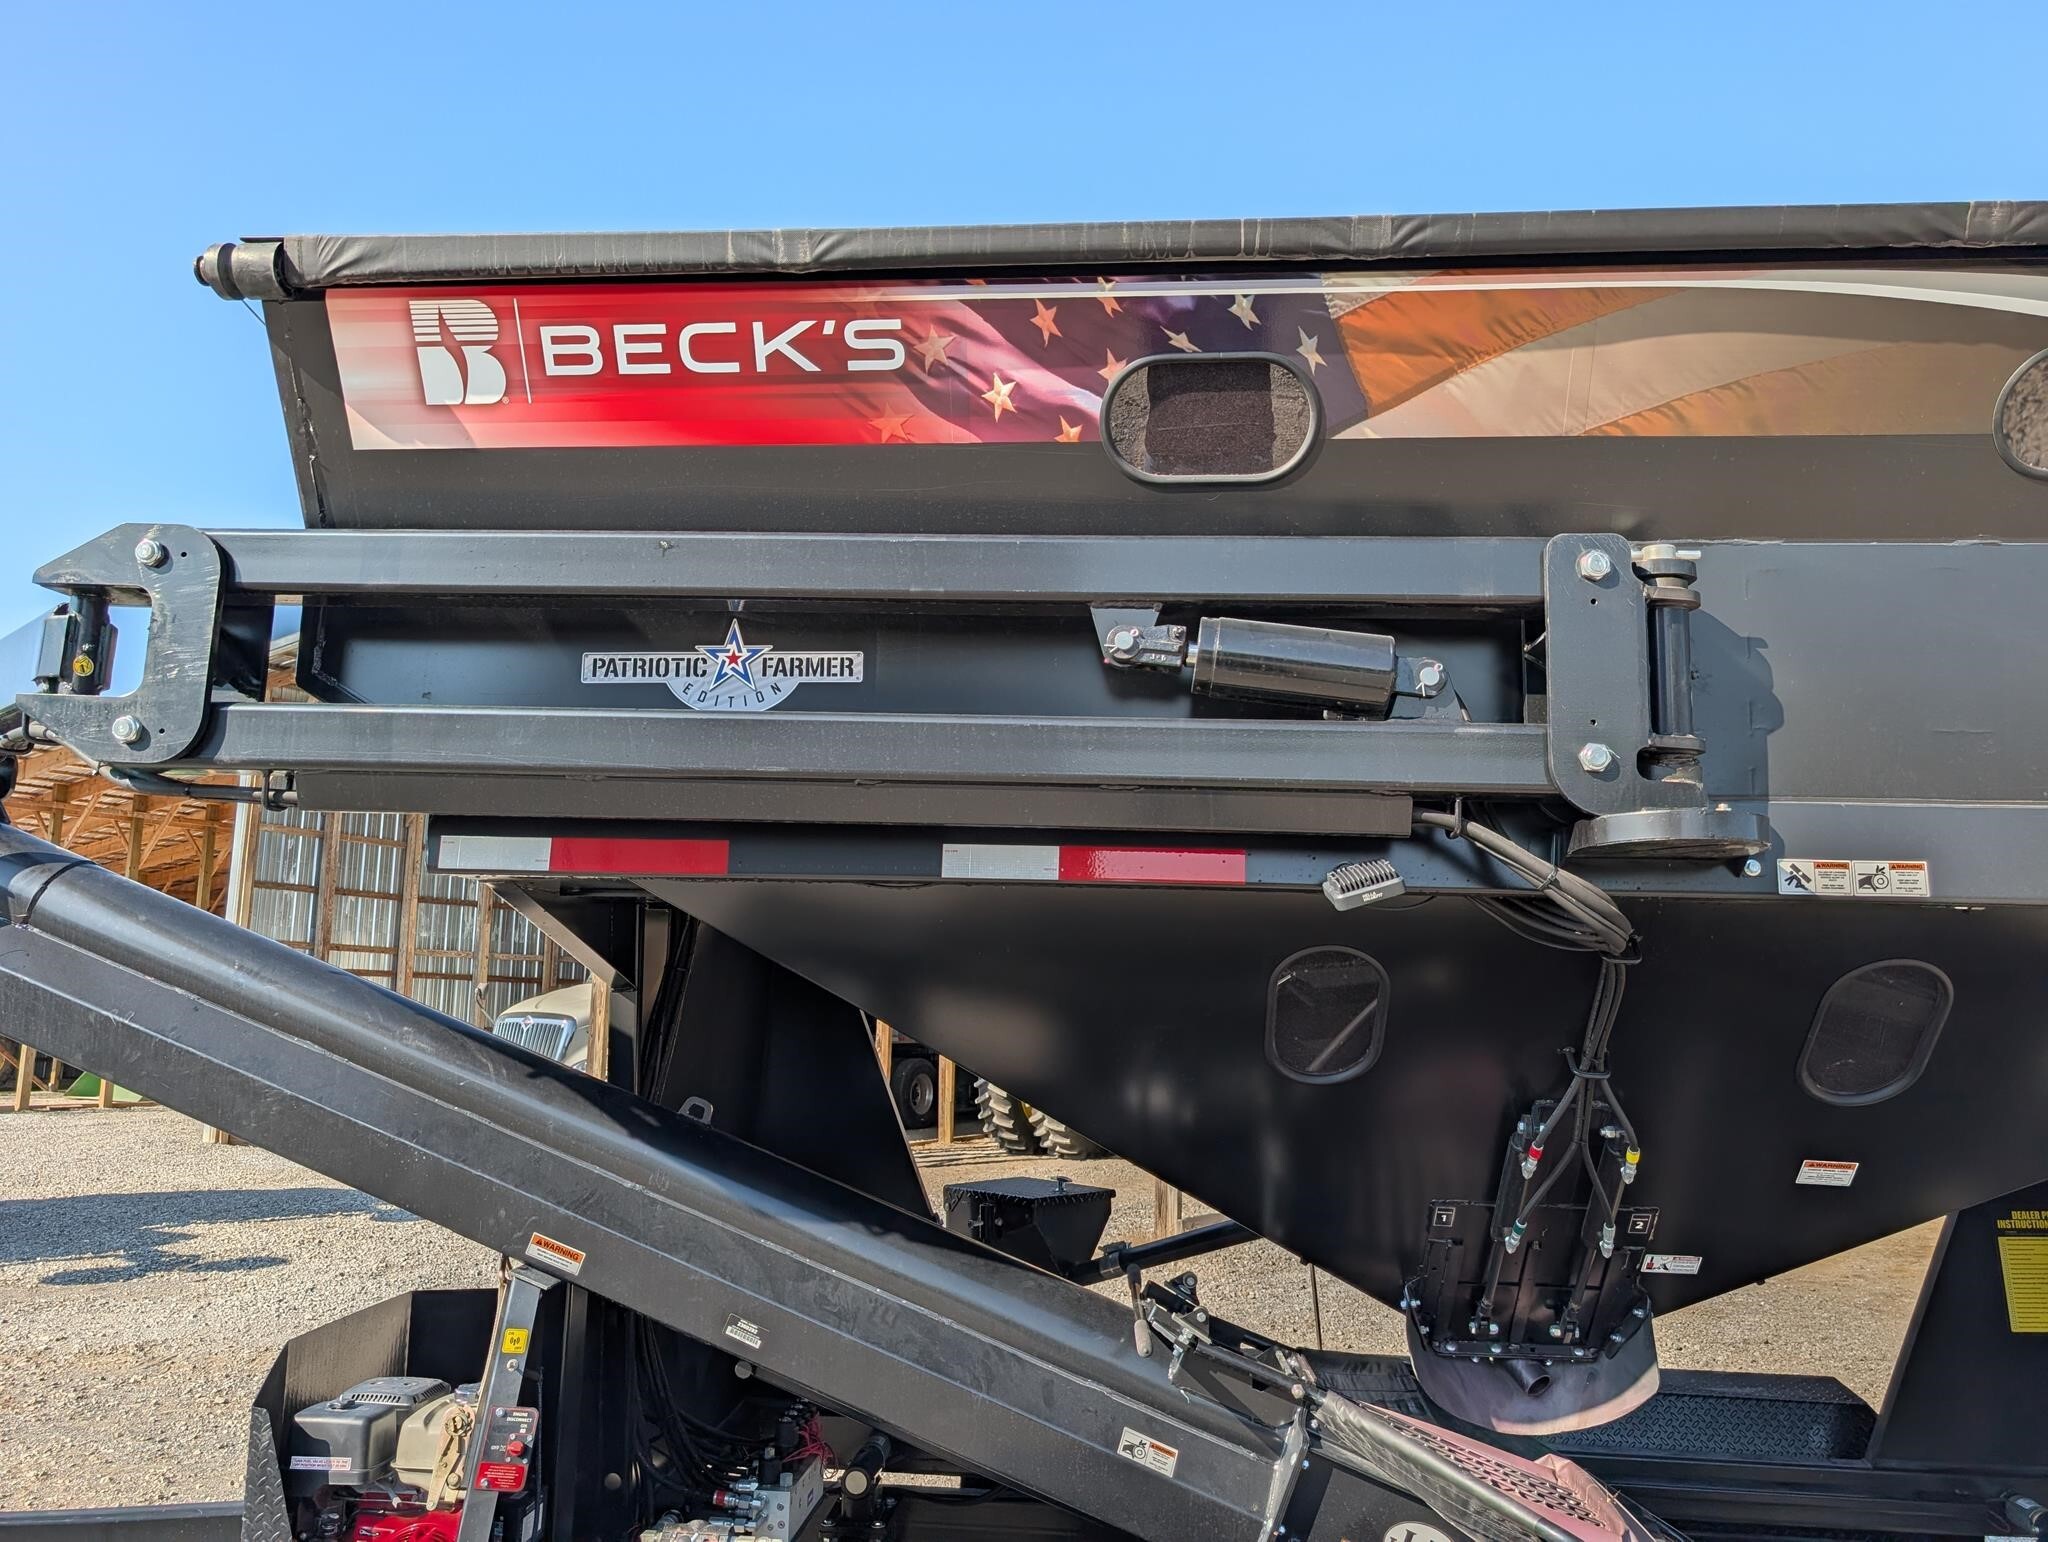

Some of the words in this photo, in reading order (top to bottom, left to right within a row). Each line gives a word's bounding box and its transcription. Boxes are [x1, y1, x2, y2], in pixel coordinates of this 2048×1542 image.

[539, 318, 906, 377] BECK'S
[591, 657, 708, 678] PATRIOTIC
[761, 656, 855, 678] FARMER
[682, 682, 782, 708] EDITION
[1635, 1221, 1644, 1229] 2
[2011, 1210, 2040, 1219] DEALER
[543, 1239, 580, 1261] WARNING
